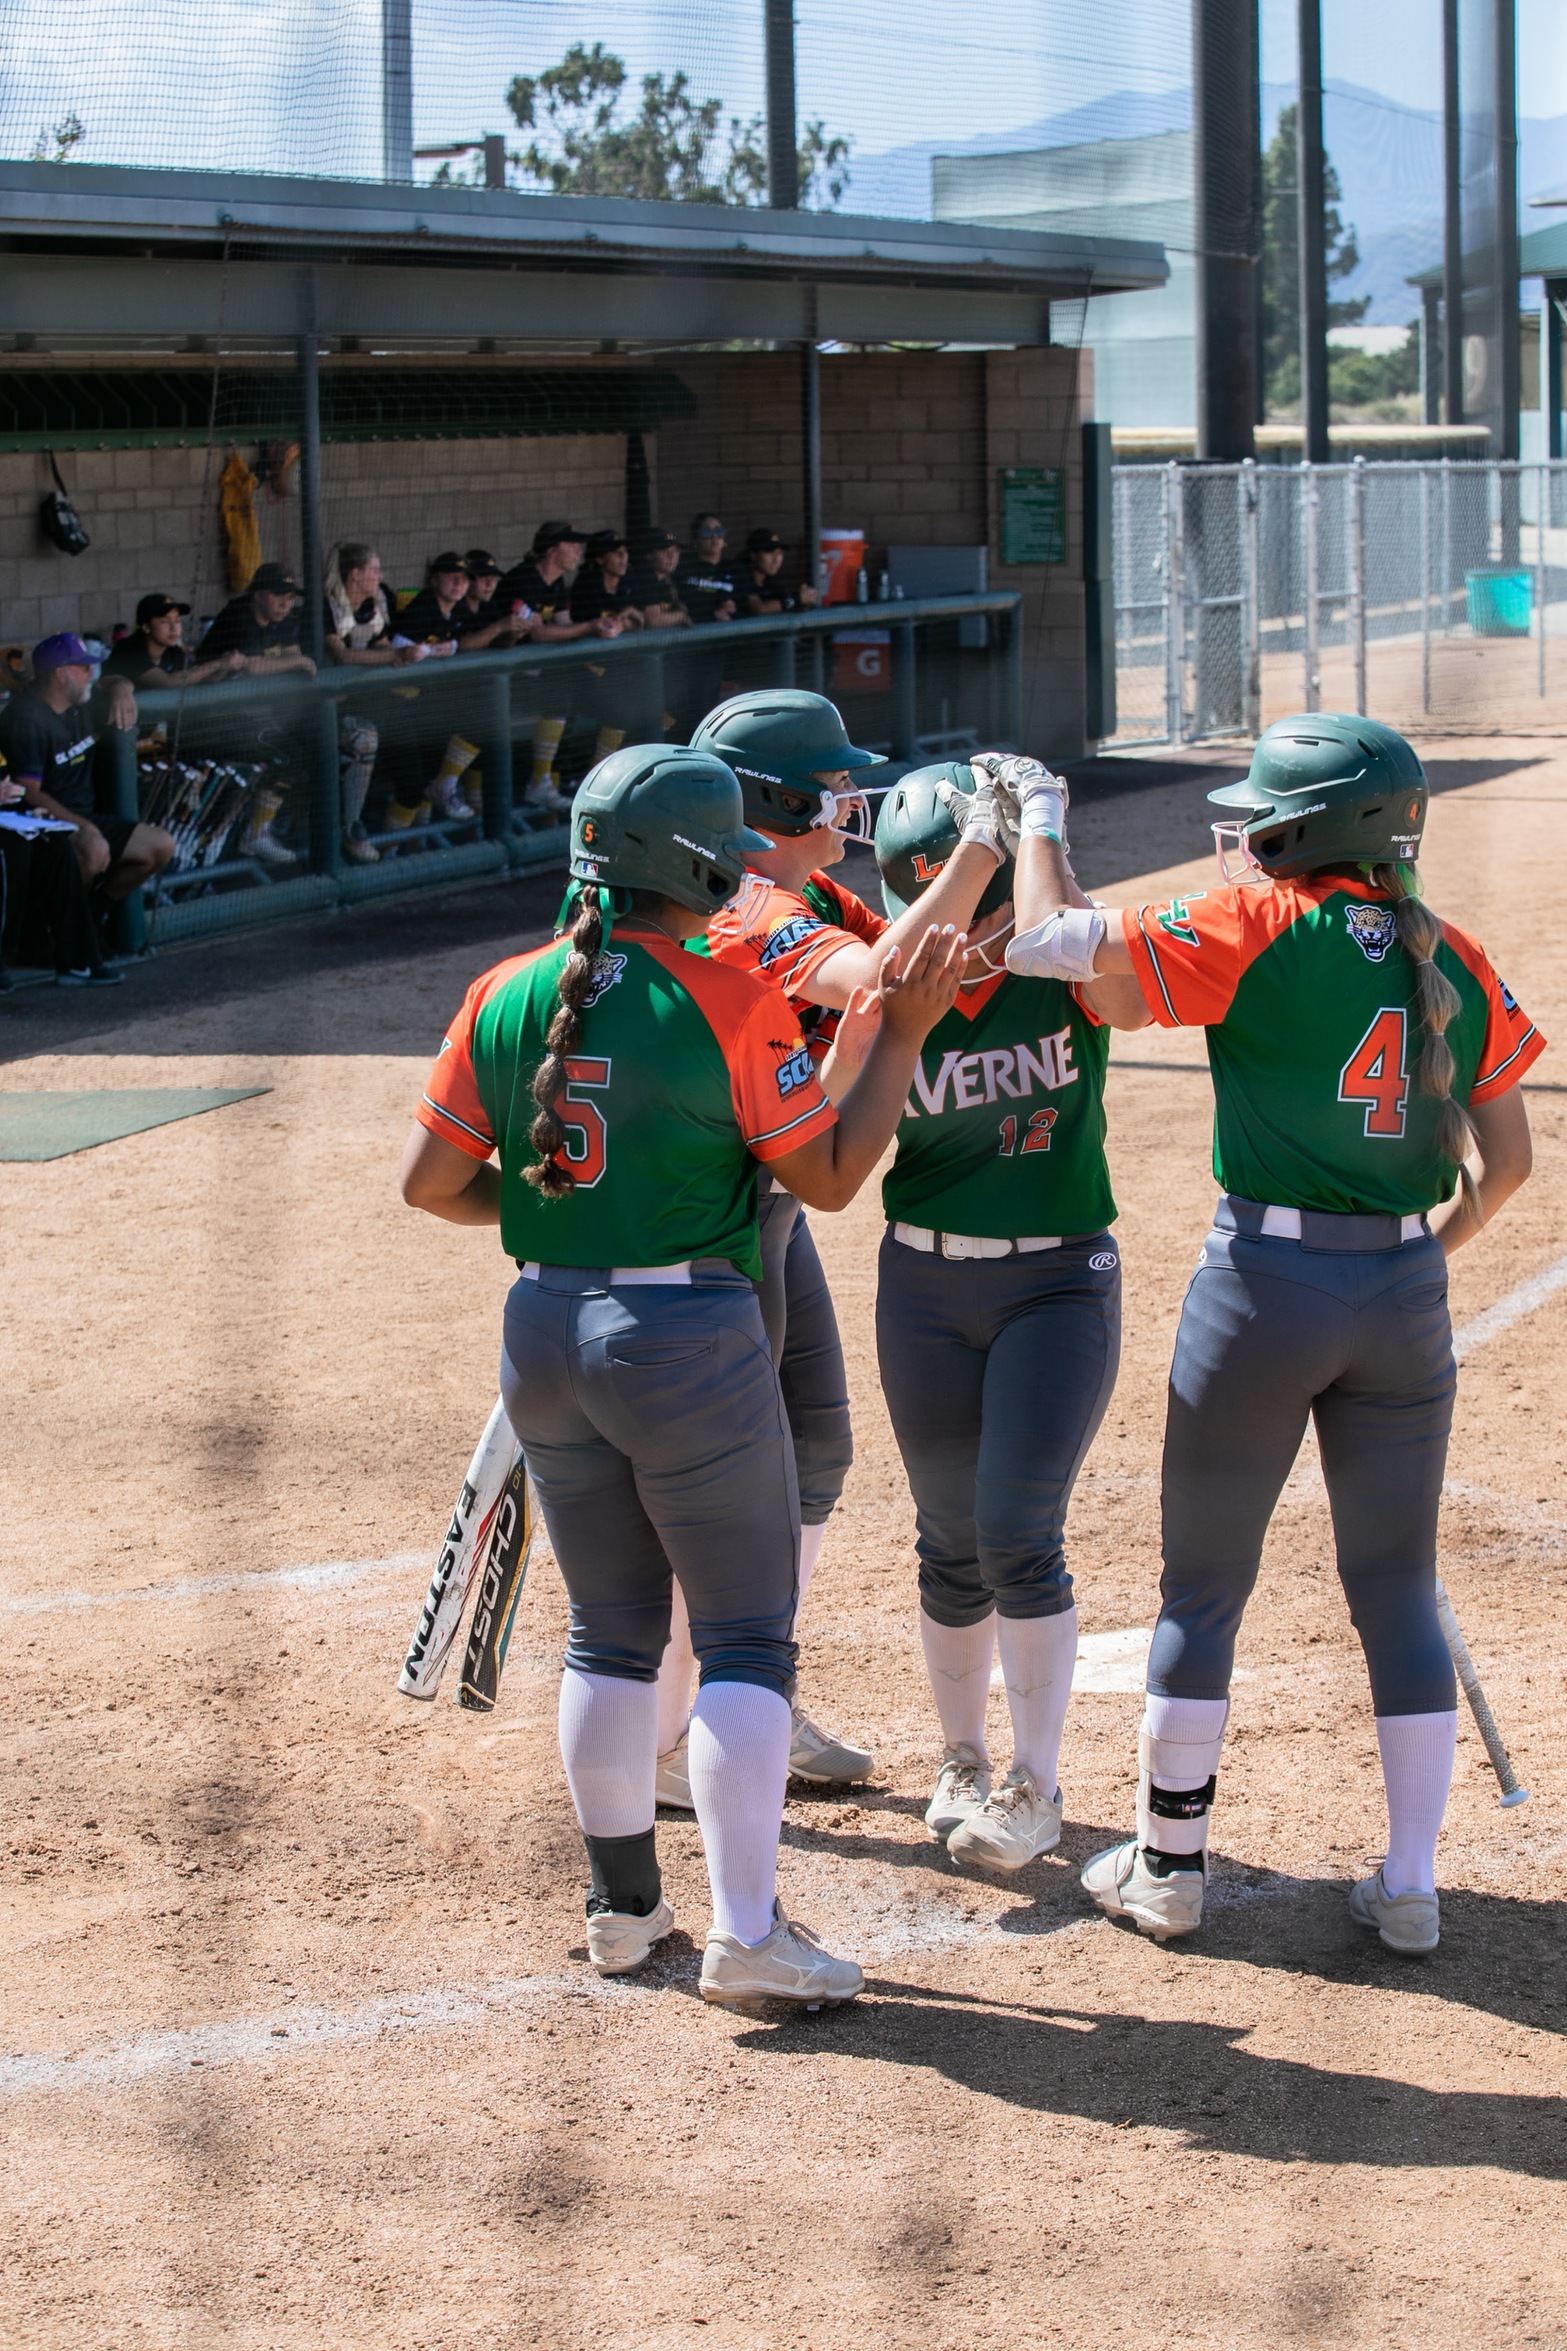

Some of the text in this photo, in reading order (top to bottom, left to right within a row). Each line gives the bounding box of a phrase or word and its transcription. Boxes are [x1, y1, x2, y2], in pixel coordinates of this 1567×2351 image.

[734, 766, 782, 784] RAWLINGS
[1278, 802, 1327, 822] RAWLINGS
[1409, 803, 1417, 821] 4
[585, 823, 594, 842] 5
[672, 833, 717, 861] RAWLINGS
[911, 853, 950, 882] L
[1337, 1007, 1410, 1138] 4
[546, 1053, 612, 1189] 5
[999, 1107, 1059, 1156] 12
[405, 1479, 478, 1682] EASTON
